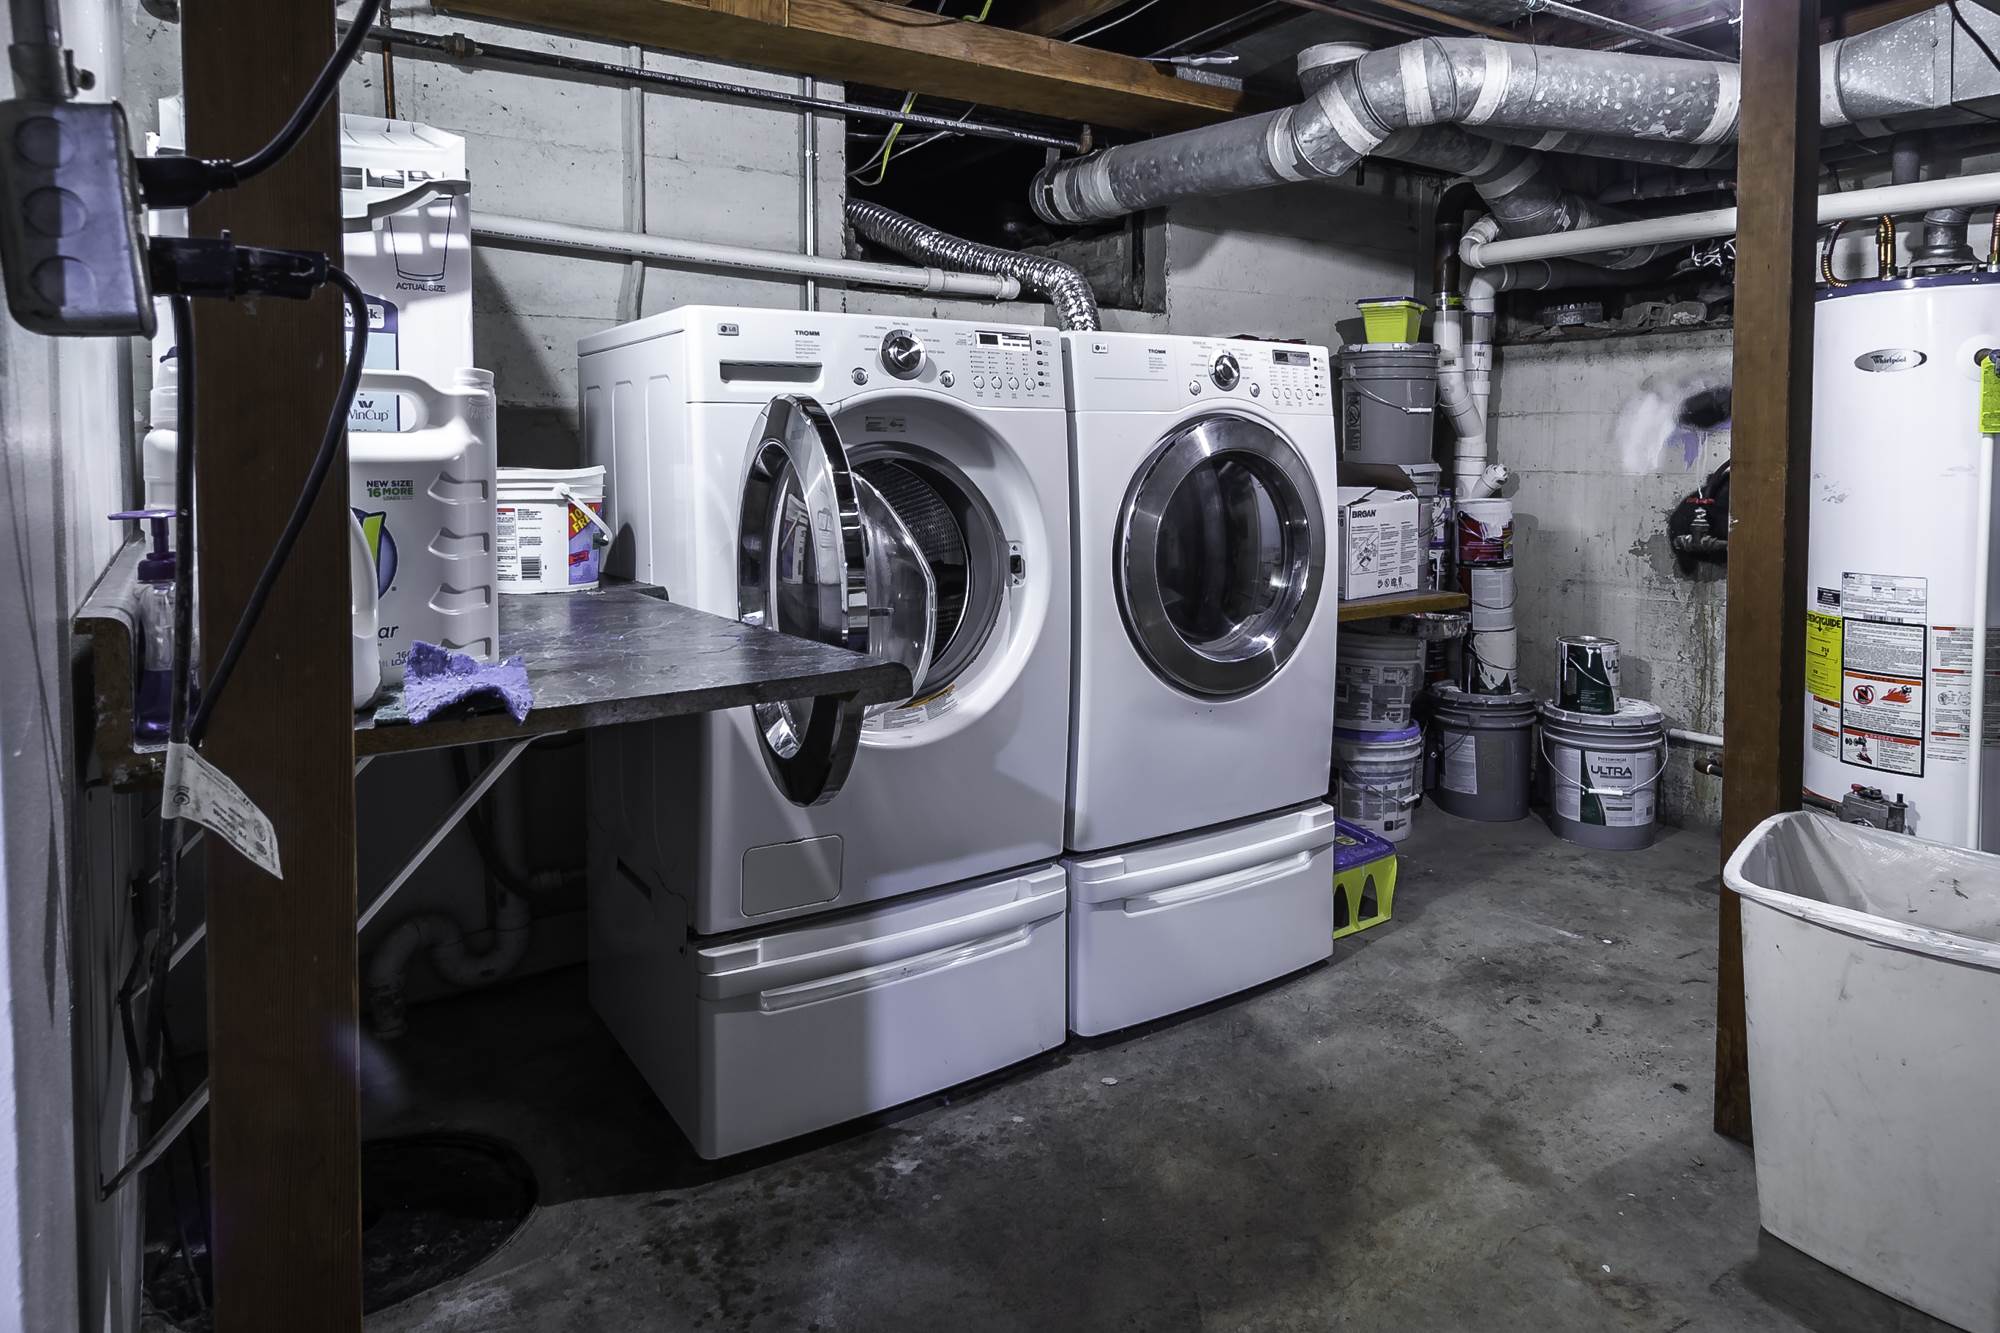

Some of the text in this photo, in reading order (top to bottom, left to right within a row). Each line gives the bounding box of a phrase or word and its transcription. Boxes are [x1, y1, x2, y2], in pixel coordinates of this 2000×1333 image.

[396, 282, 447, 292] ACTUAL SIZE
[366, 480, 388, 488] NEW
[368, 487, 414, 498] 16 MORE
[1590, 764, 1632, 776] ULTRA
